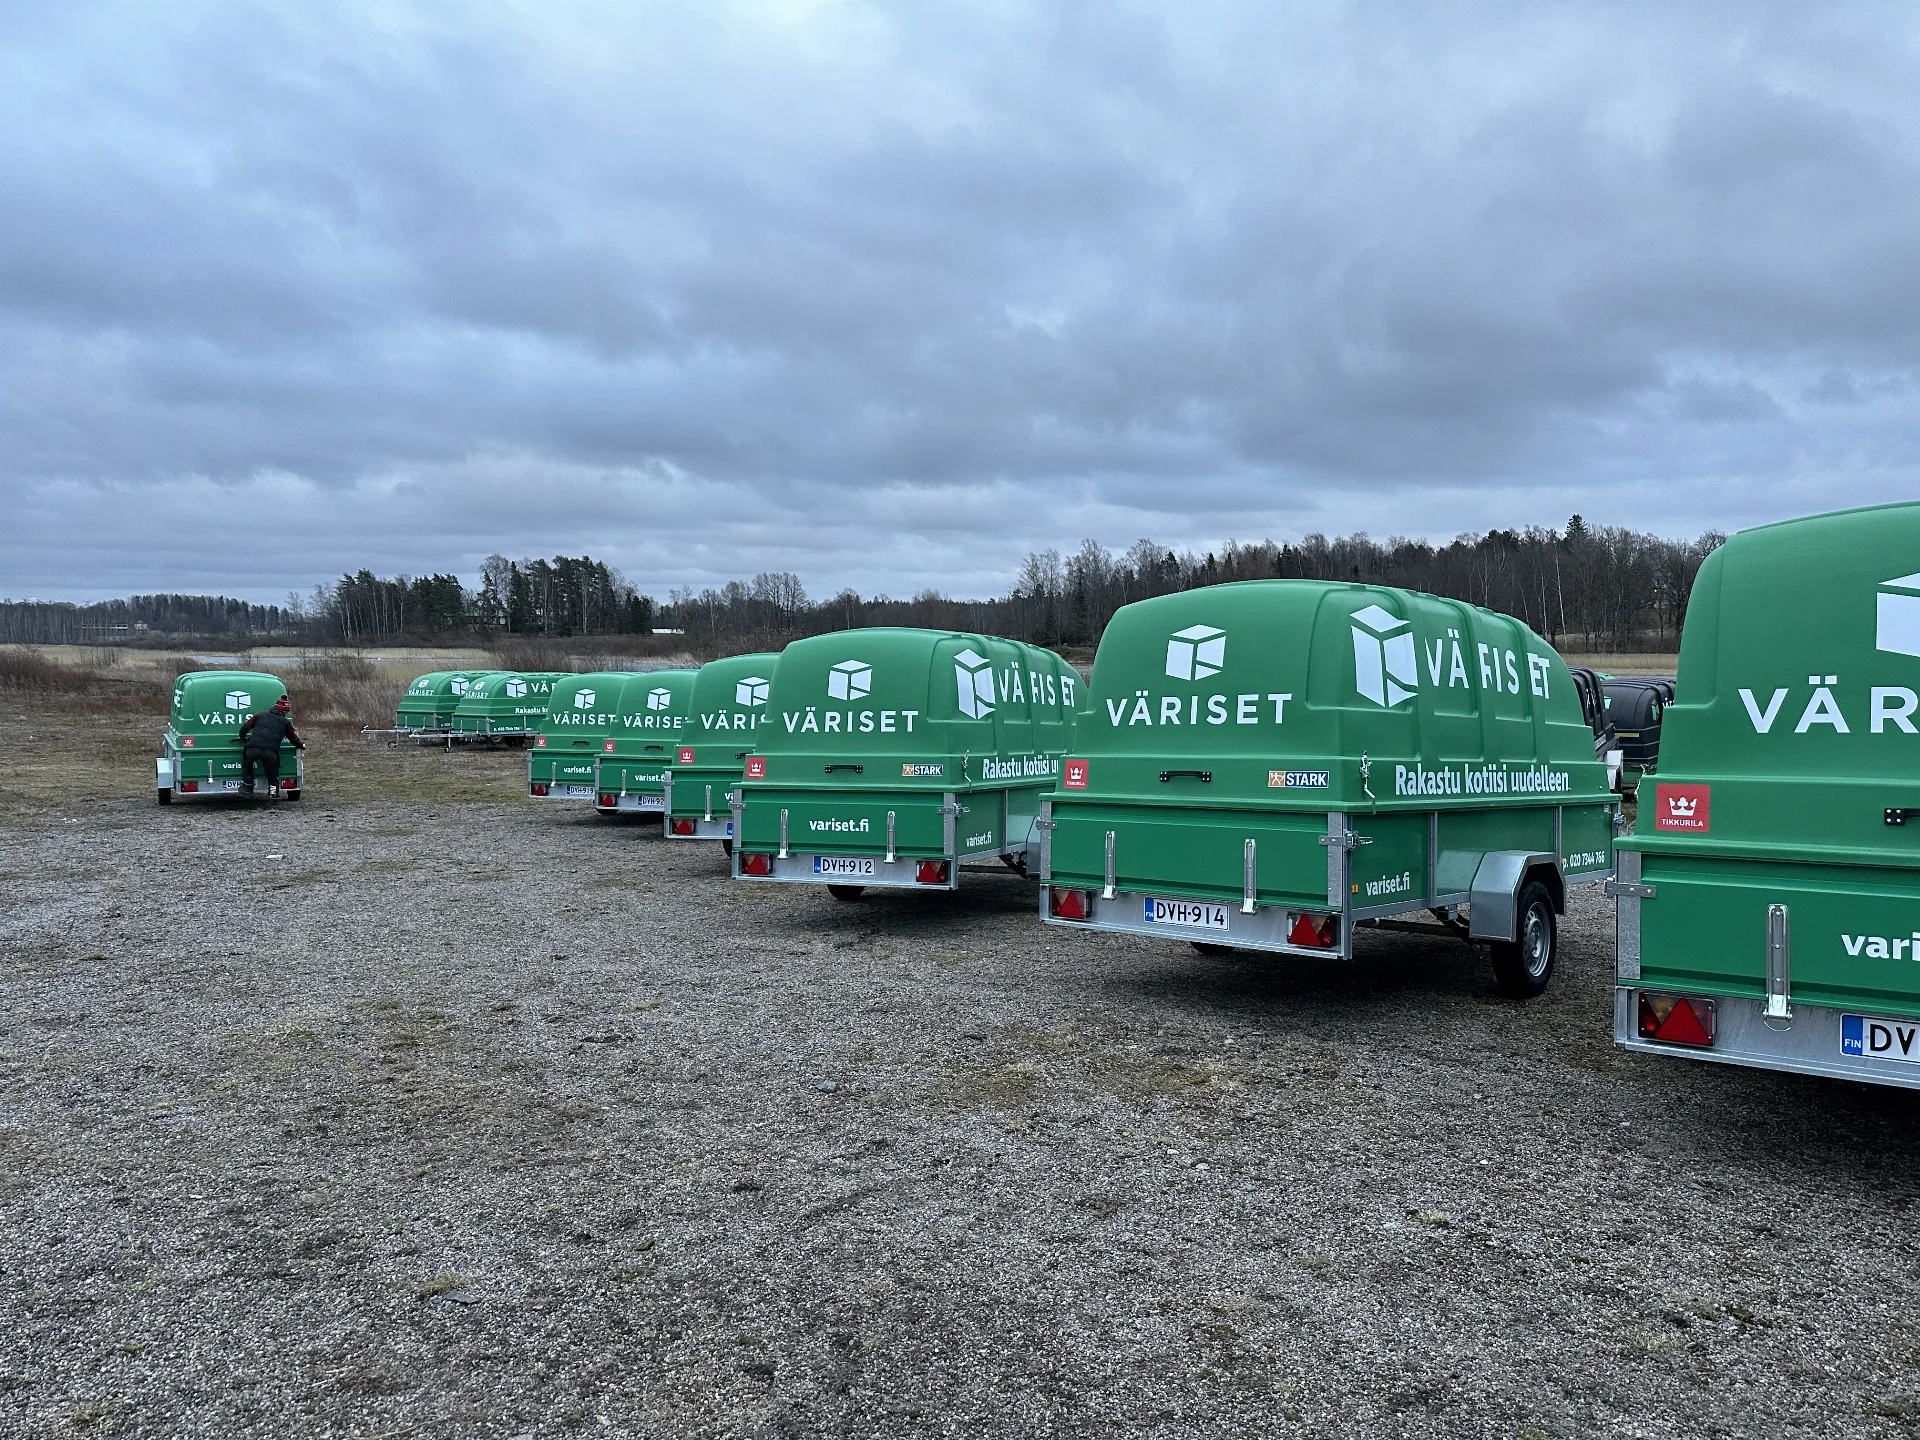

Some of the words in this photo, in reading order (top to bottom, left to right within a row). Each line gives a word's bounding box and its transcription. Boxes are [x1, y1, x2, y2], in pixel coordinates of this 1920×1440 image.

[1106, 690, 1293, 727] VÄRISET
[1738, 675, 1919, 733] VÄR
[623, 713, 688, 728] VÄRISE
[783, 706, 919, 733] VÄRISET
[563, 766, 591, 774] variset.fi
[914, 765, 941, 775] STARK
[983, 757, 1021, 779] Rakastu
[1024, 755, 1049, 775] kotiisi
[1286, 772, 1327, 786] STARK
[1395, 763, 1460, 795] Rakastu
[1465, 763, 1507, 793] kotiisi
[808, 817, 869, 832] variset.fi
[1661, 818, 1704, 827] TIKKURILA
[965, 830, 992, 848] variset.fi
[822, 858, 873, 874] DVH-912
[1365, 871, 1410, 896] variset.fi
[1156, 901, 1225, 926] DVH-914
[1844, 1038, 1862, 1049] FIN
[1869, 1023, 1916, 1056] DV
